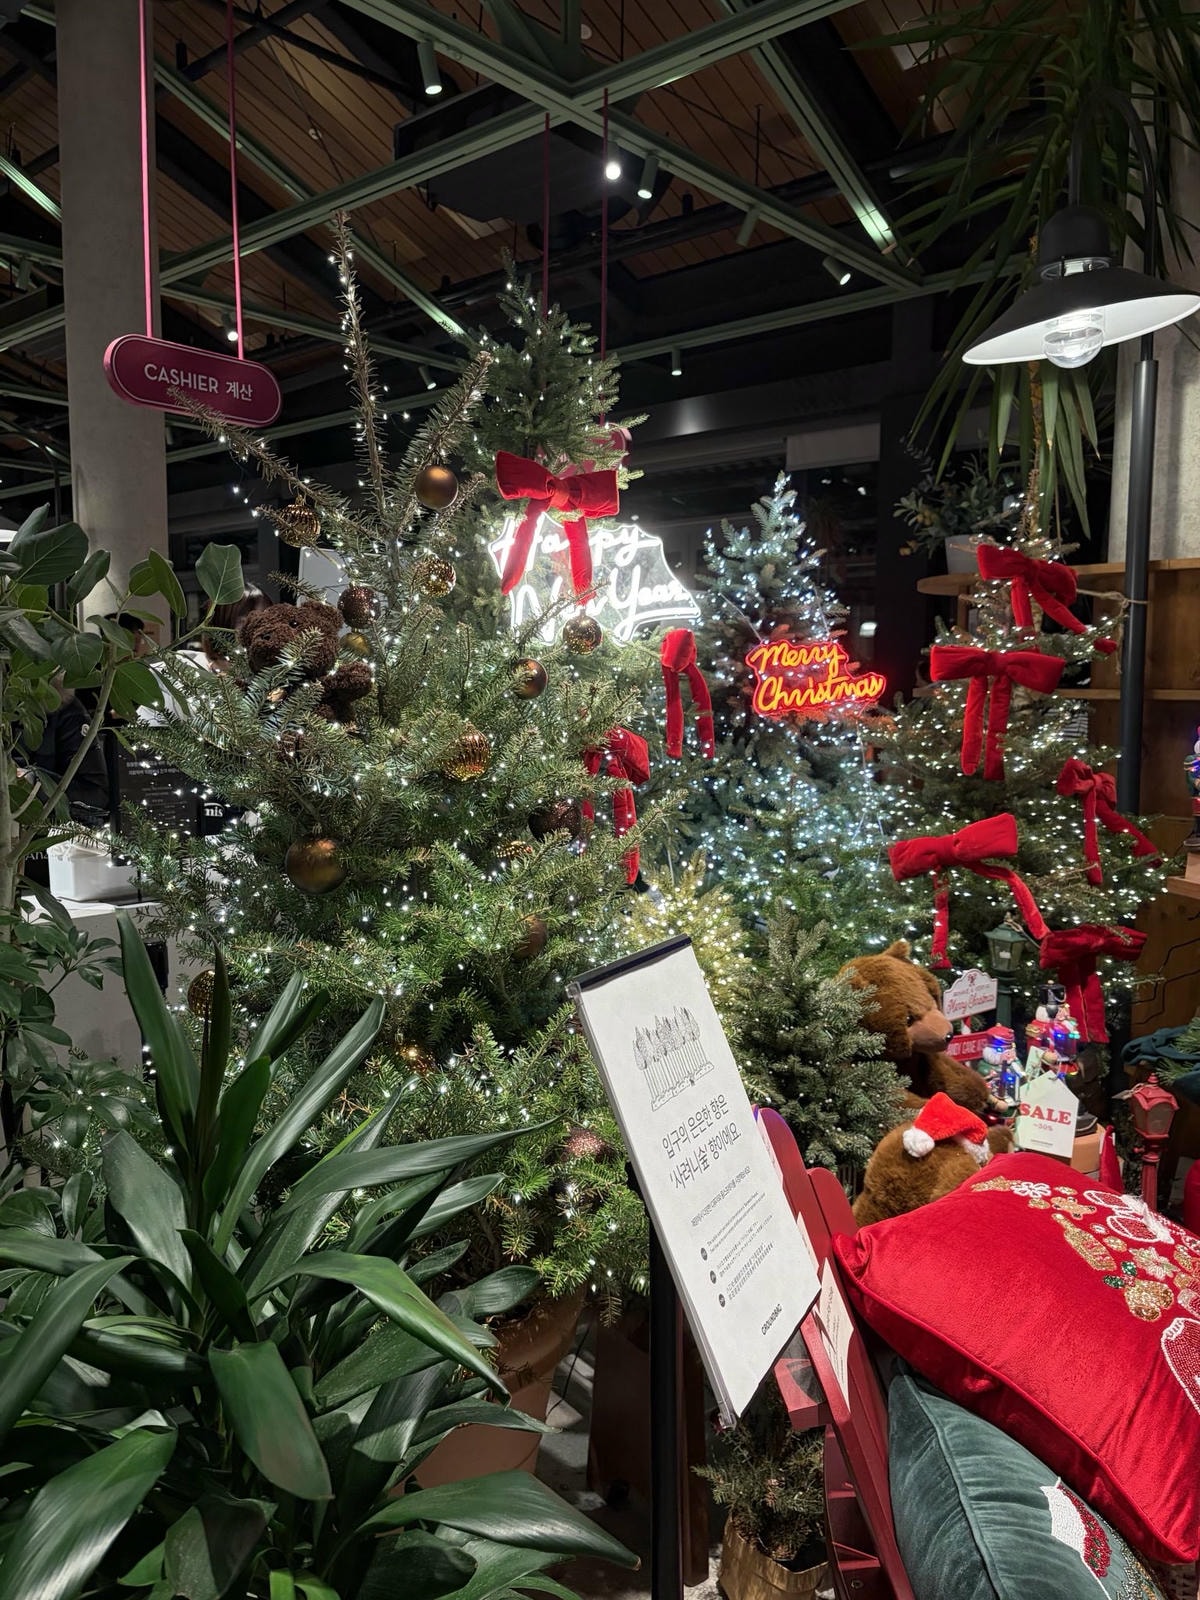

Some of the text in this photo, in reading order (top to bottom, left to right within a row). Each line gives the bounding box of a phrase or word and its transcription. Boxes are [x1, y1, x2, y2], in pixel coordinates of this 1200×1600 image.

[144, 363, 253, 402] CASHIER 계산
[491, 512, 661, 572] Hapy
[750, 643, 847, 678] Merry
[758, 675, 884, 711] Christmas
[662, 1094, 729, 1159] 입구의 은은한 향은
[1019, 1102, 1072, 1126] SALE
